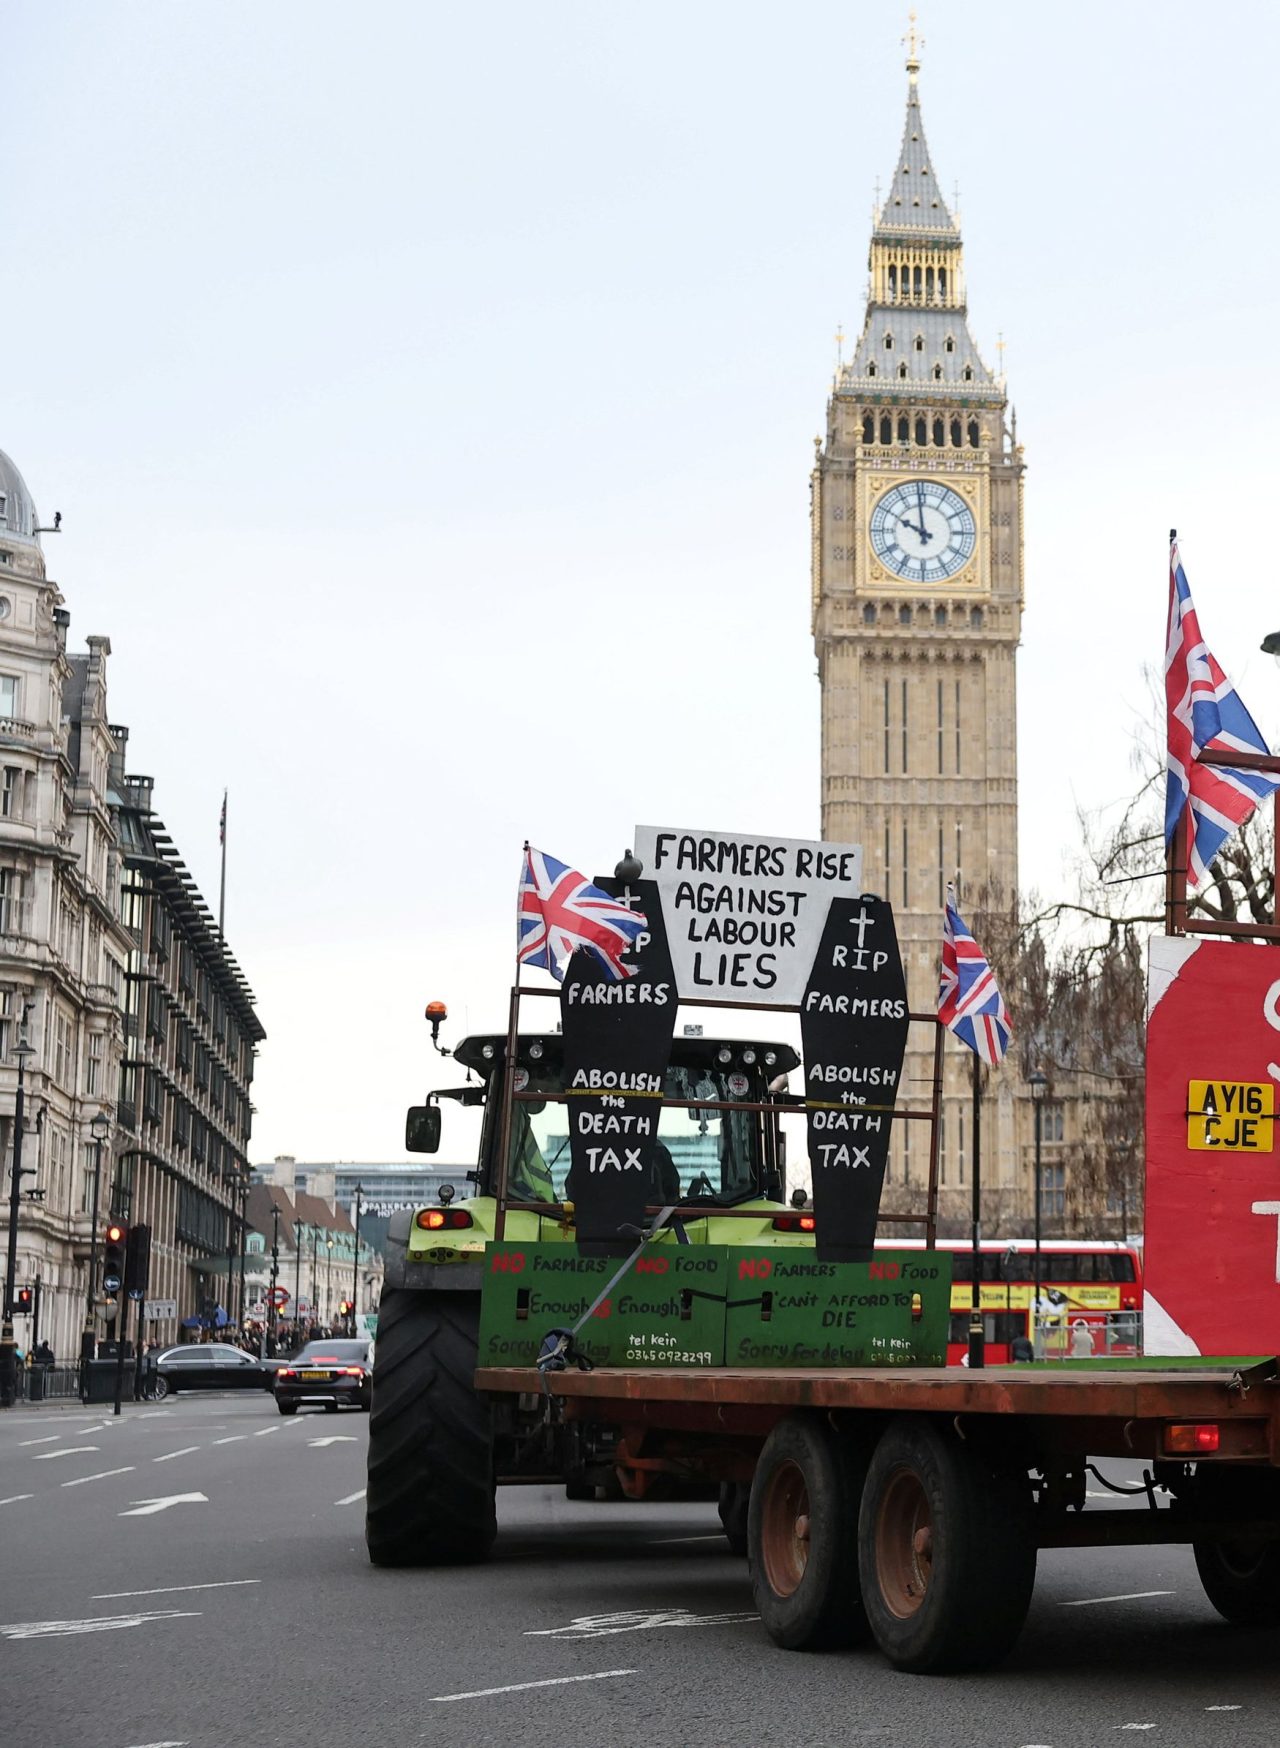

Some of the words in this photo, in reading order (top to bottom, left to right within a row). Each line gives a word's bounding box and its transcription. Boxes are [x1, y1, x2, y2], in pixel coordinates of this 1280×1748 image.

[655, 834, 787, 876] FARMERS
[796, 849, 854, 881] RISE
[675, 882, 807, 917] AGAINST
[688, 918, 795, 947] LABOUR
[833, 945, 888, 971] RIP
[694, 952, 777, 989] LIES
[569, 983, 669, 1005] FARMERS
[807, 992, 904, 1018] FARMERS
[573, 1069, 660, 1092] ABOLISH
[810, 1064, 896, 1085] ABOLISH
[601, 1095, 624, 1108] the
[841, 1092, 866, 1105] the
[1202, 1084, 1262, 1114] AY16
[579, 1112, 649, 1135] DEATH
[813, 1111, 880, 1132] DEATH
[1206, 1118, 1257, 1147] CJE
[586, 1148, 642, 1172] TAX
[818, 1144, 870, 1168] TAX
[492, 1253, 525, 1273] NO
[533, 1255, 607, 1273] FARMERS
[636, 1257, 669, 1274] NO
[739, 1258, 772, 1280] NO
[774, 1262, 836, 1277] FARMERS
[870, 1262, 899, 1280] NO
[901, 1262, 939, 1280] FOOD
[531, 1293, 590, 1320] Enough
[618, 1296, 679, 1317] Enough
[828, 1295, 890, 1308] AFFORD
[822, 1312, 856, 1328] DIE
[629, 1334, 646, 1346] tel
[738, 1337, 788, 1360] Sorry
[872, 1337, 886, 1348] tel
